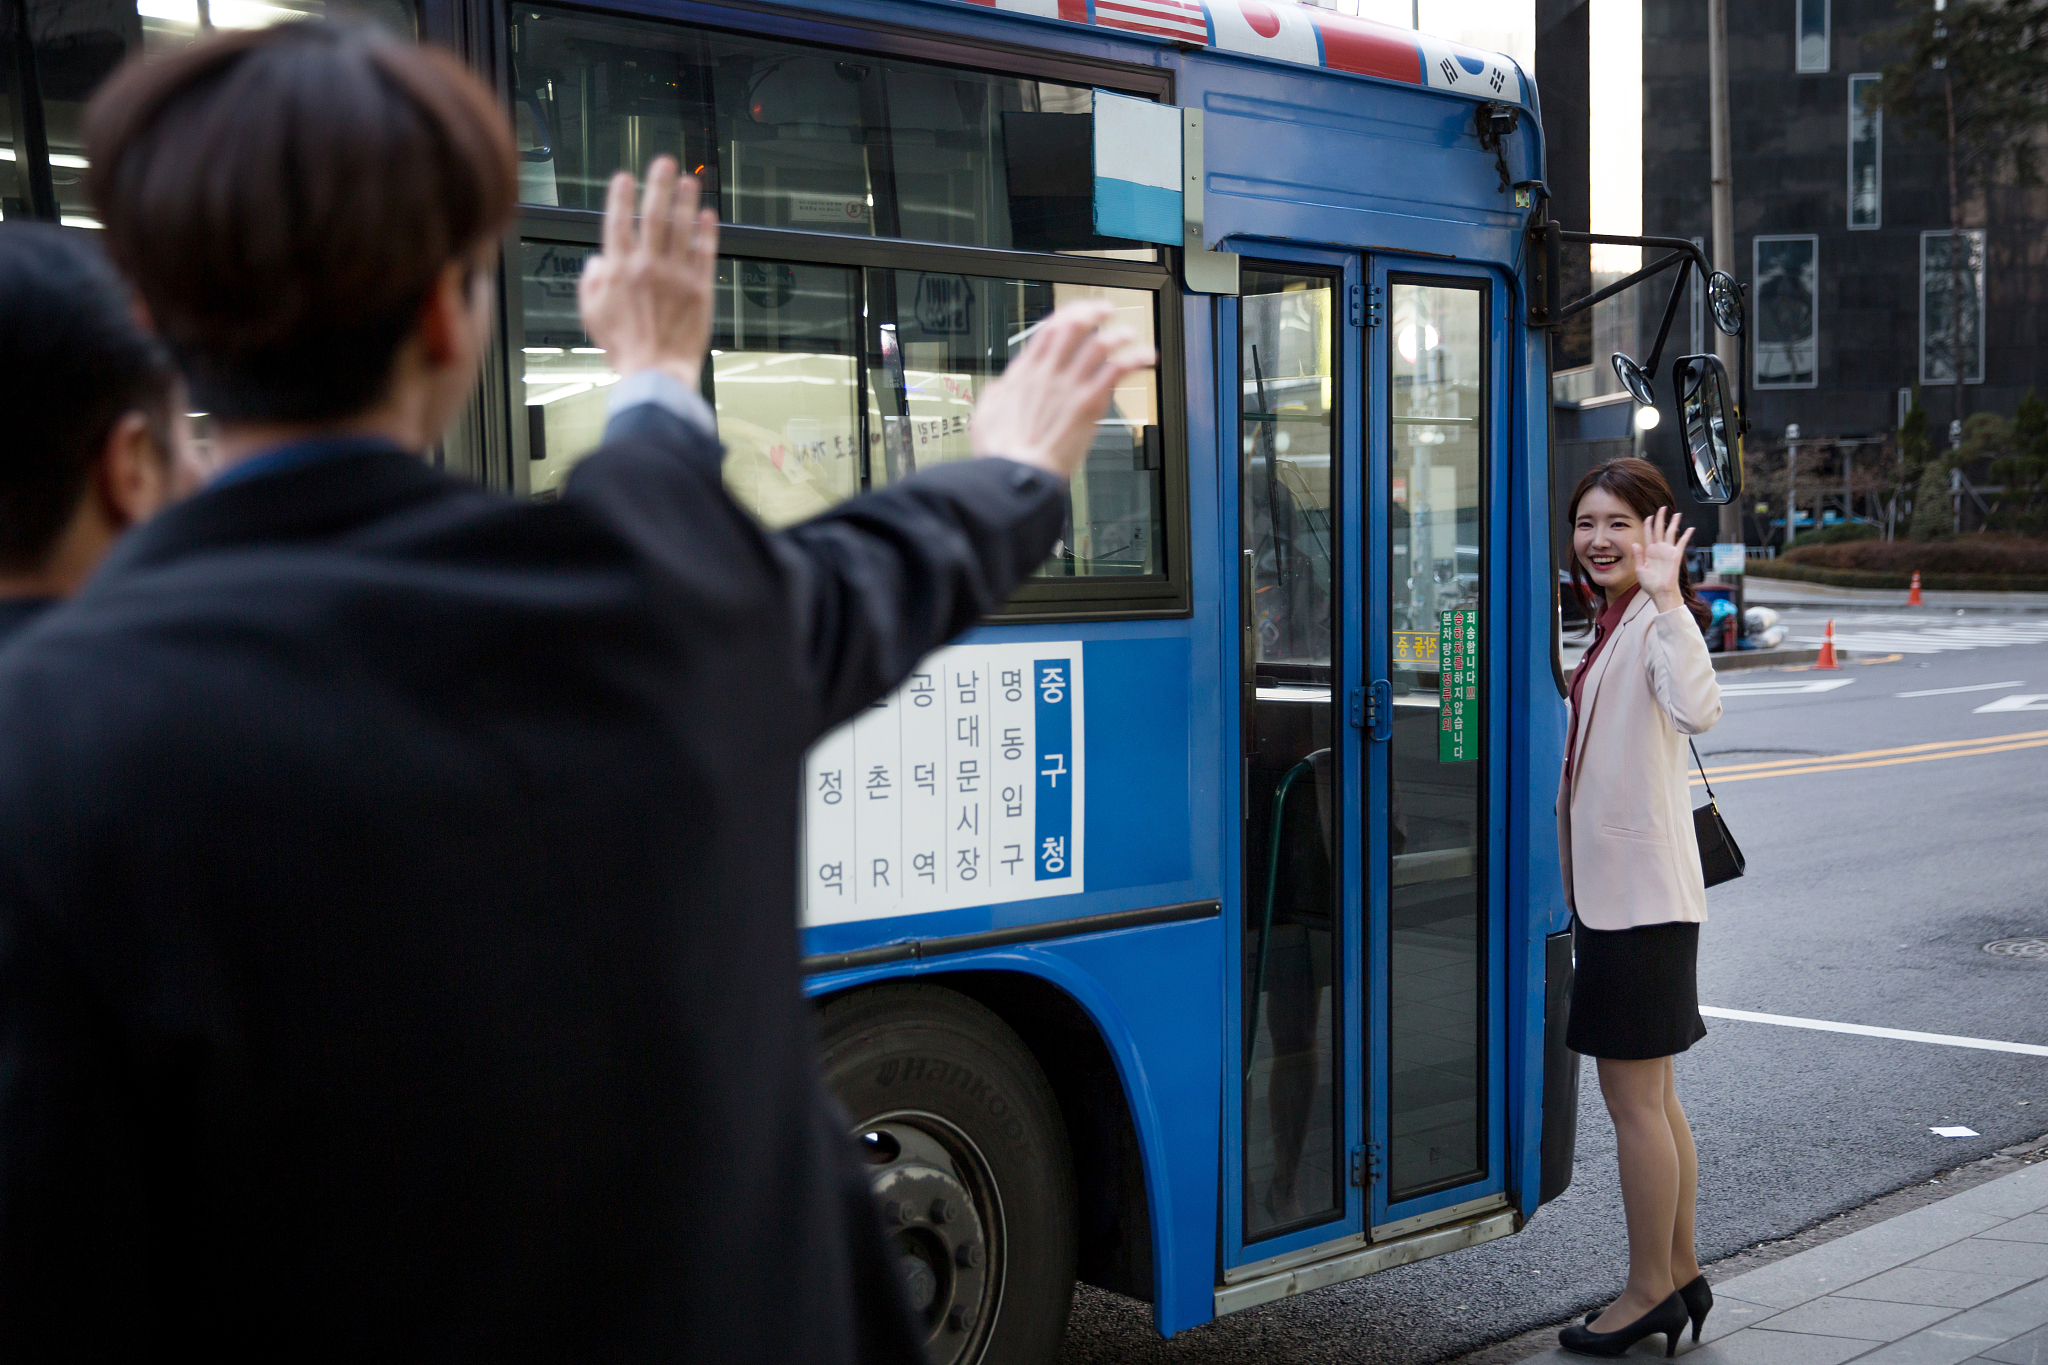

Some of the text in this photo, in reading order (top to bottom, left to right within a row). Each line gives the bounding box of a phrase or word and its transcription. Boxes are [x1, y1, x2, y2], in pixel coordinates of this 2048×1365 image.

[818, 769, 843, 896] 정역
[865, 702, 892, 888] 촌R
[910, 673, 935, 885] 공덕역
[956, 670, 981, 881] 남대문시장
[1000, 668, 1025, 876] 명동입구
[1039, 667, 1067, 873] 중구청
